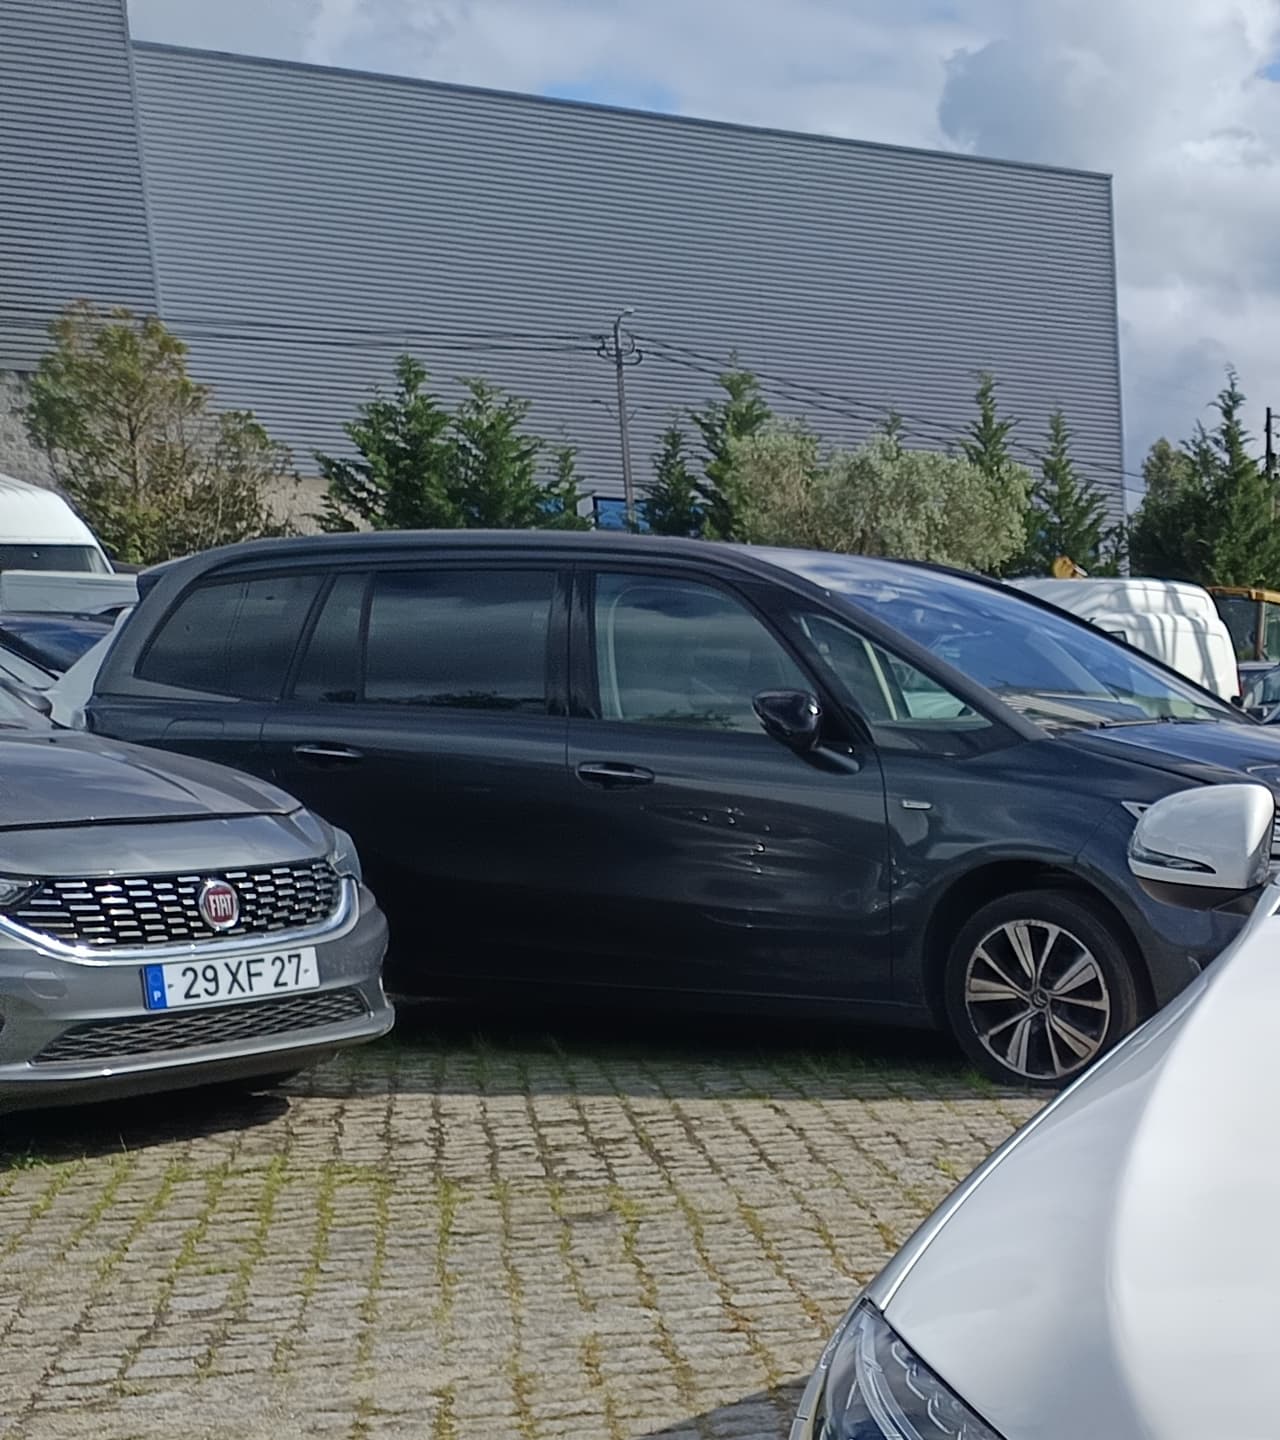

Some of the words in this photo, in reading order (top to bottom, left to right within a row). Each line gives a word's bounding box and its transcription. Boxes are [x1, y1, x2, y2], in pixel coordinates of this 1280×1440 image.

[208, 894, 232, 917] FIAT
[181, 965, 219, 999] 29
[224, 958, 265, 994] XF
[271, 953, 302, 988] 27
[153, 991, 161, 1002] P
